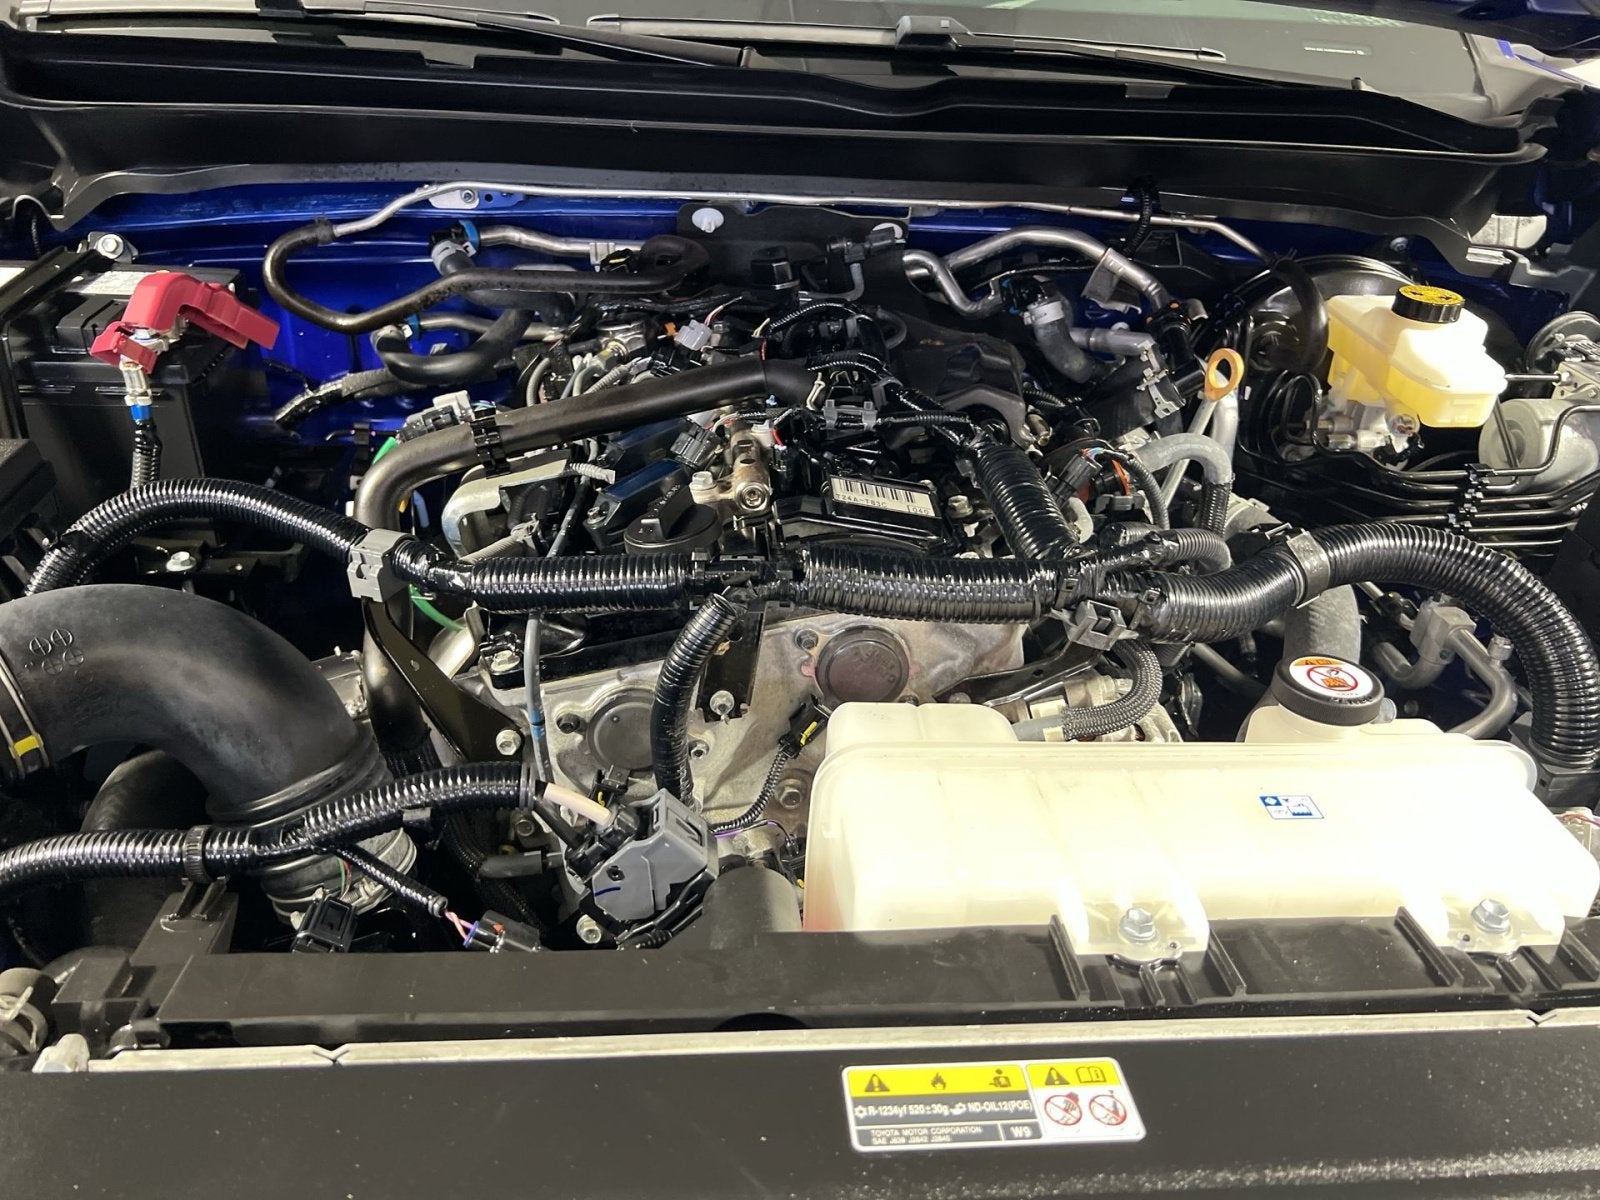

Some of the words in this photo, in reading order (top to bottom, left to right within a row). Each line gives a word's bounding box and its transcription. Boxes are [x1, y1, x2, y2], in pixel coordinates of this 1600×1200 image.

[871, 1129, 900, 1137] TOYOTA
[902, 1128, 929, 1136] MOTOR
[930, 1126, 983, 1135] CORPORATION
[1010, 1126, 1032, 1138] W9
